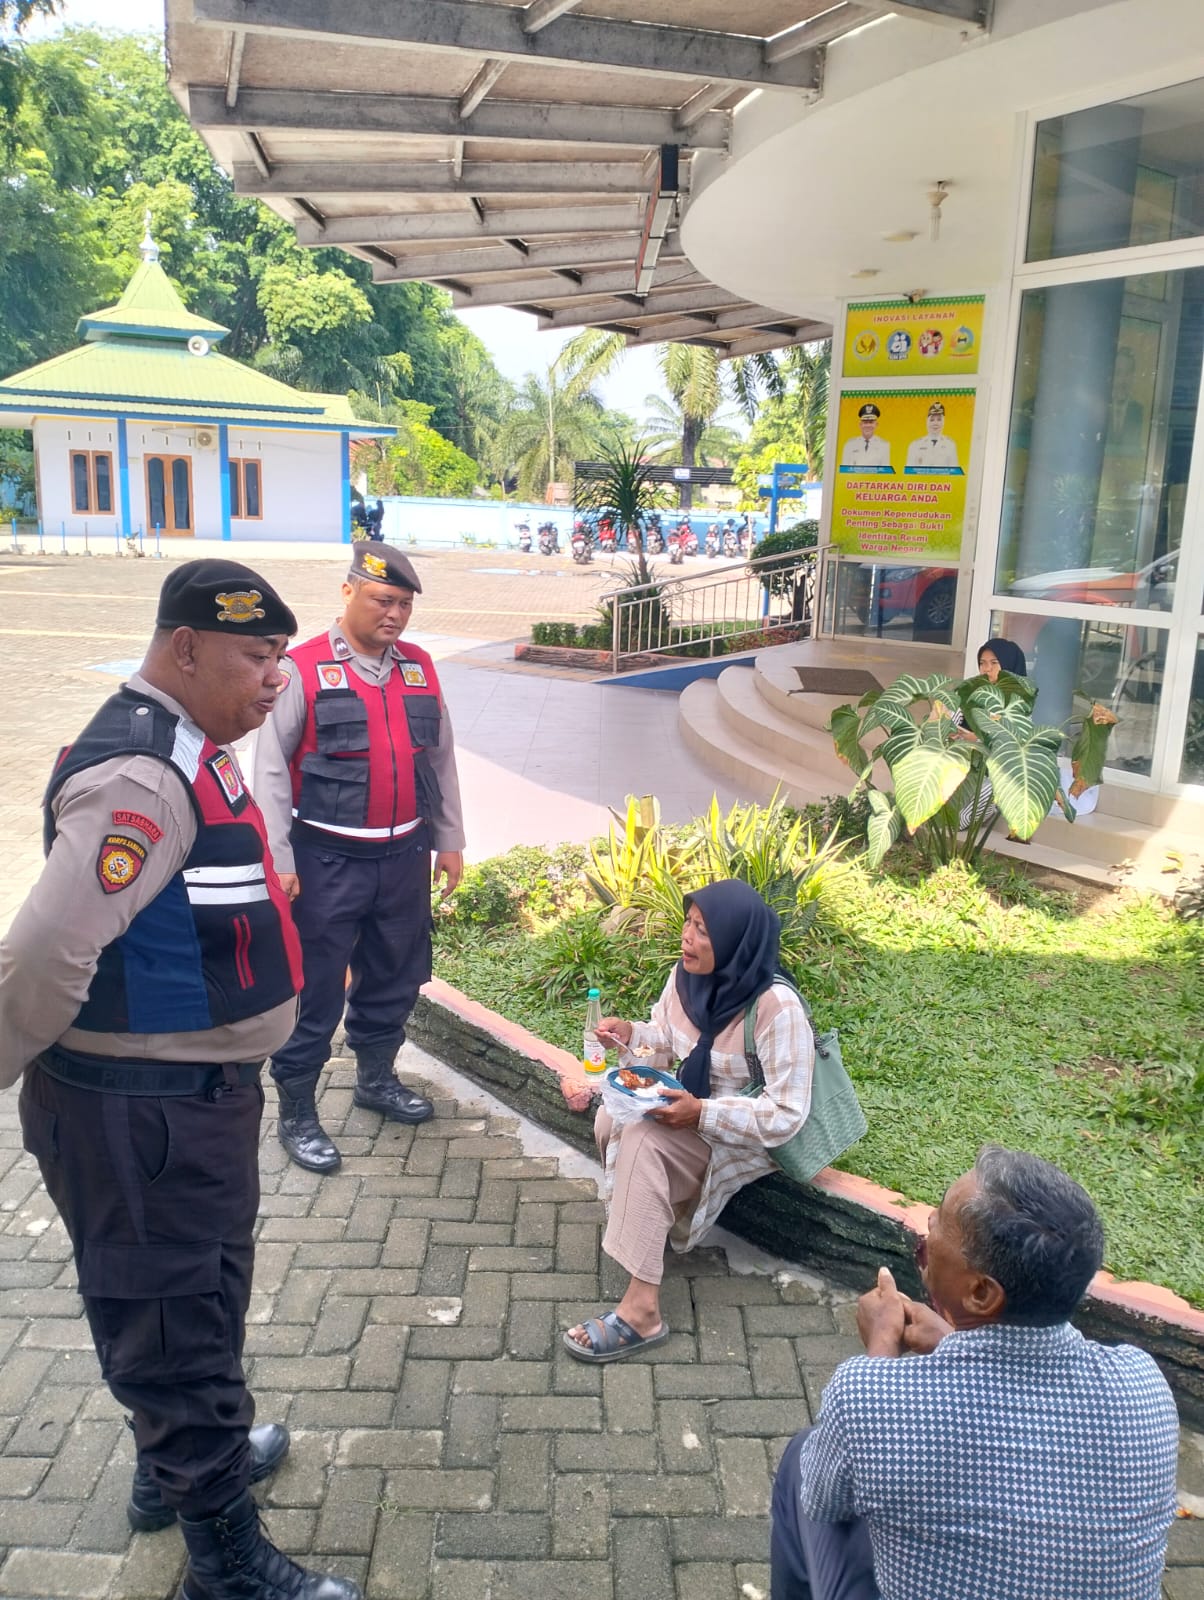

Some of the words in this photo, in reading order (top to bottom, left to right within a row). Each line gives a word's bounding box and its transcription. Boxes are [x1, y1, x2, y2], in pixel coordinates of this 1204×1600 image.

[912, 312, 955, 321] LAYANAN
[855, 493, 907, 502] KELUARGA
[884, 510, 951, 520] Kependudukan
[846, 520, 878, 529] Penting
[881, 521, 916, 530] Sebagai
[899, 534, 927, 543] Resmi
[890, 545, 923, 554] Negara
[101, 1070, 161, 1090] POLRI
